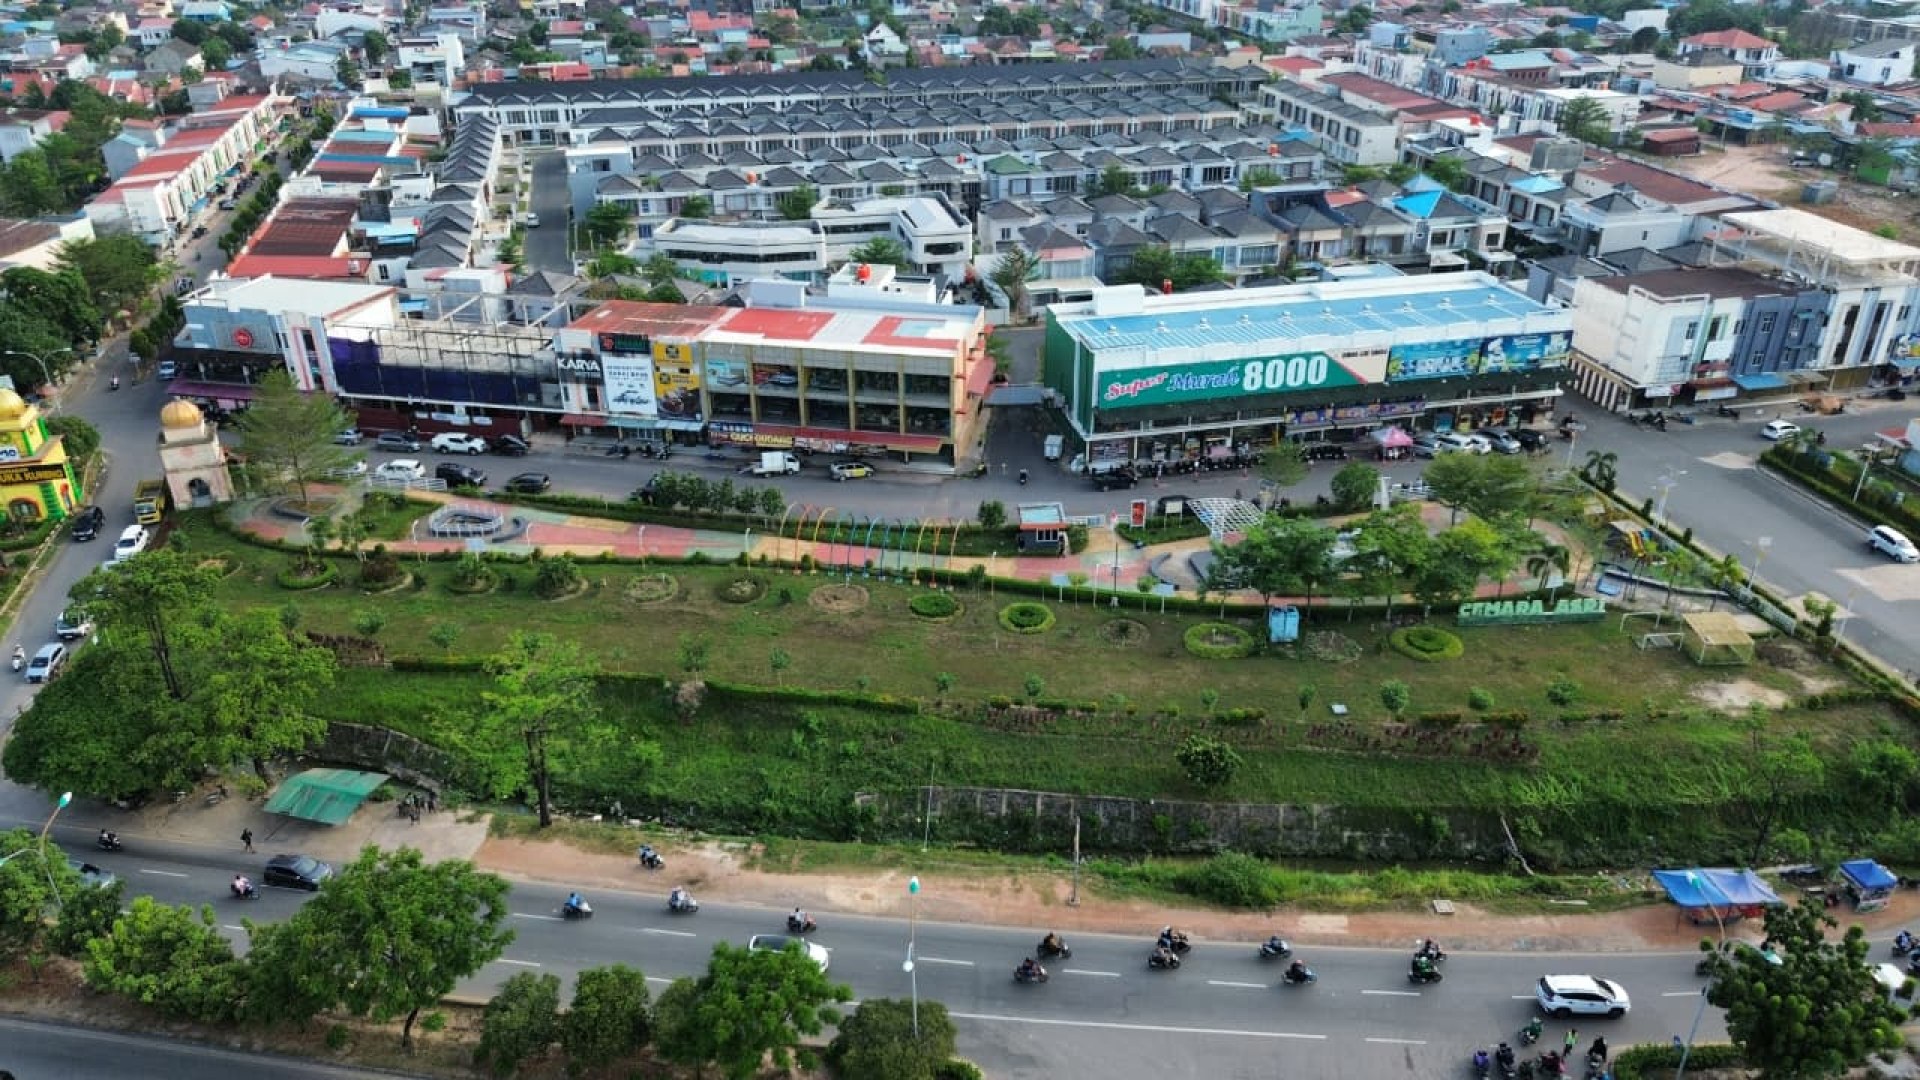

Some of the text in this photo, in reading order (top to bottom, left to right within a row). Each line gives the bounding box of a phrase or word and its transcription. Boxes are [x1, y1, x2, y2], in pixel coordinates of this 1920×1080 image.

[557, 357, 601, 372] KARYA
[1105, 355, 1328, 401] Super Murah 8000
